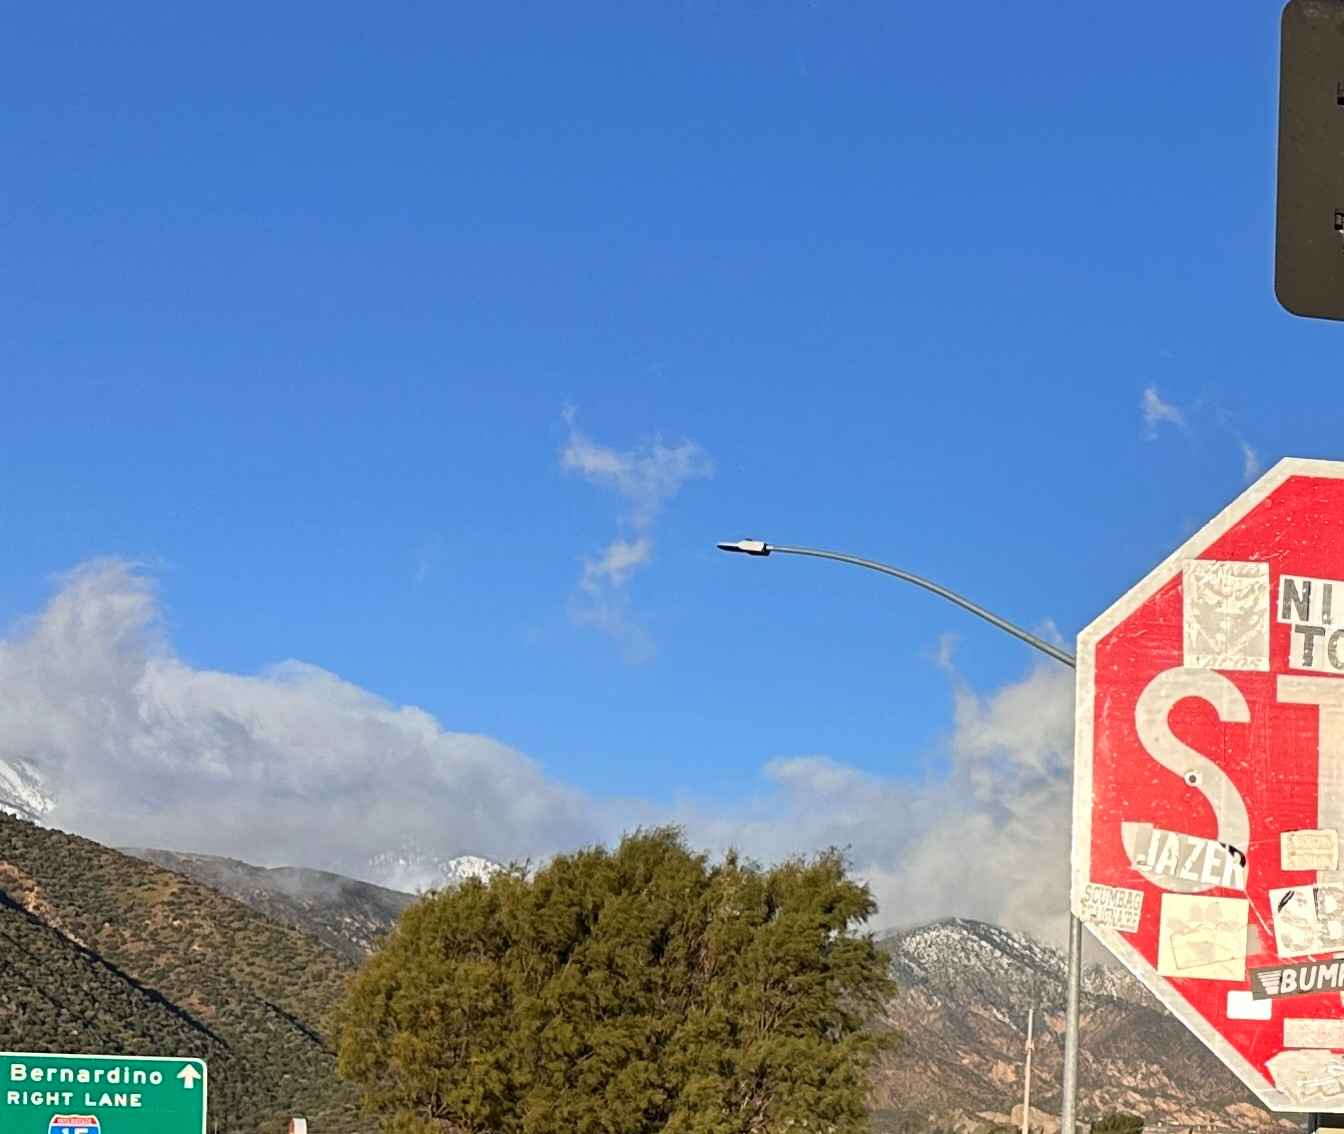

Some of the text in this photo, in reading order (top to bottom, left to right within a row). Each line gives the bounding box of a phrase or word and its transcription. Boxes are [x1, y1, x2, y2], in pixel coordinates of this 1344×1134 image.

[1135, 828, 1245, 891] JAZER
[10, 1063, 163, 1085] Bernardino
[7, 1091, 142, 1107] RIGHT LANE
